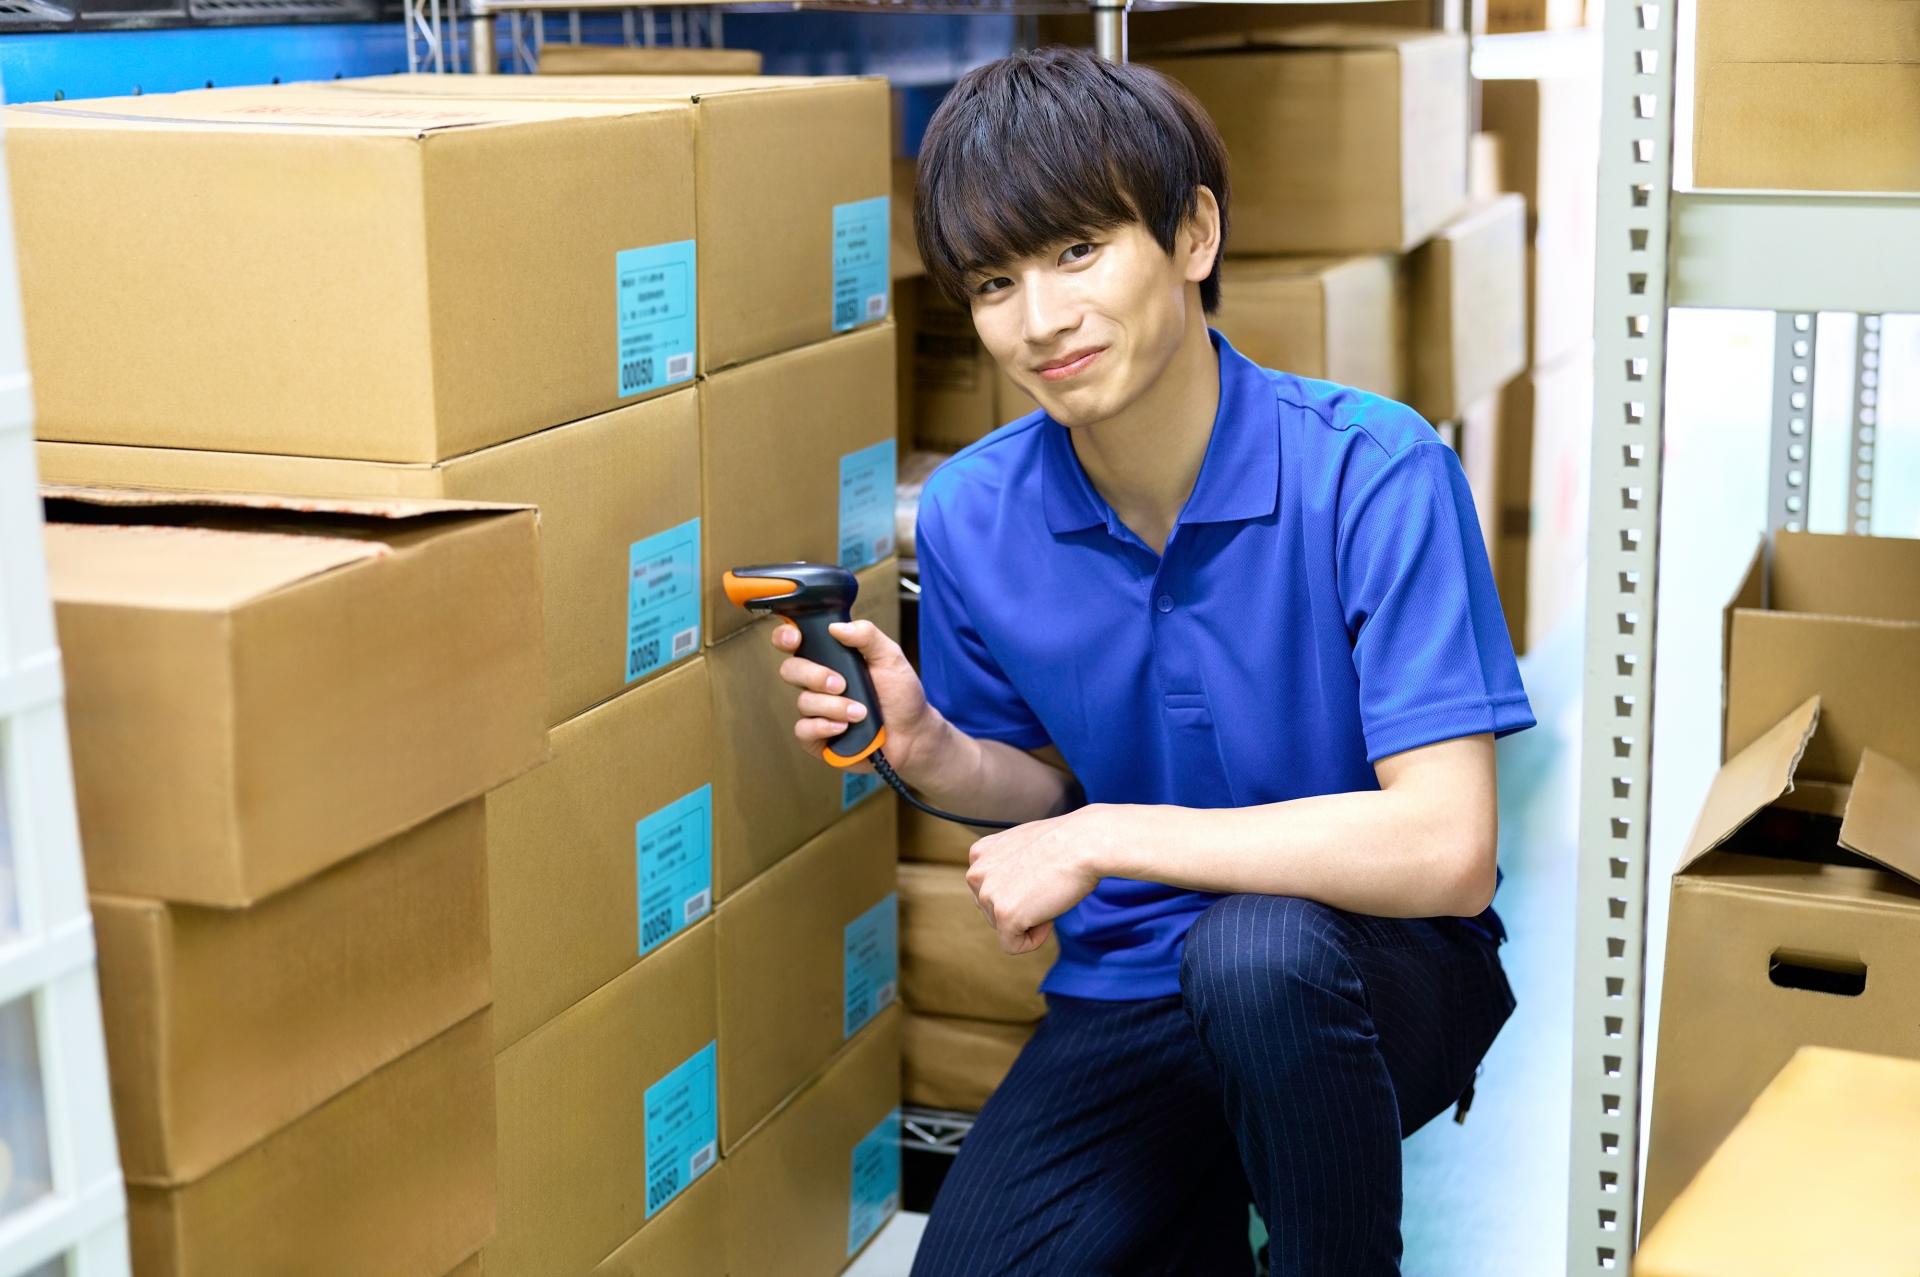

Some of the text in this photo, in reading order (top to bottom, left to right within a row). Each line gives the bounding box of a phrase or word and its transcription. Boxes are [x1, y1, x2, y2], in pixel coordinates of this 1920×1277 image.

[622, 357, 654, 390] 00050
[630, 639, 661, 675] 00050
[643, 907, 673, 947] 00050
[649, 1167, 679, 1210] 00050
